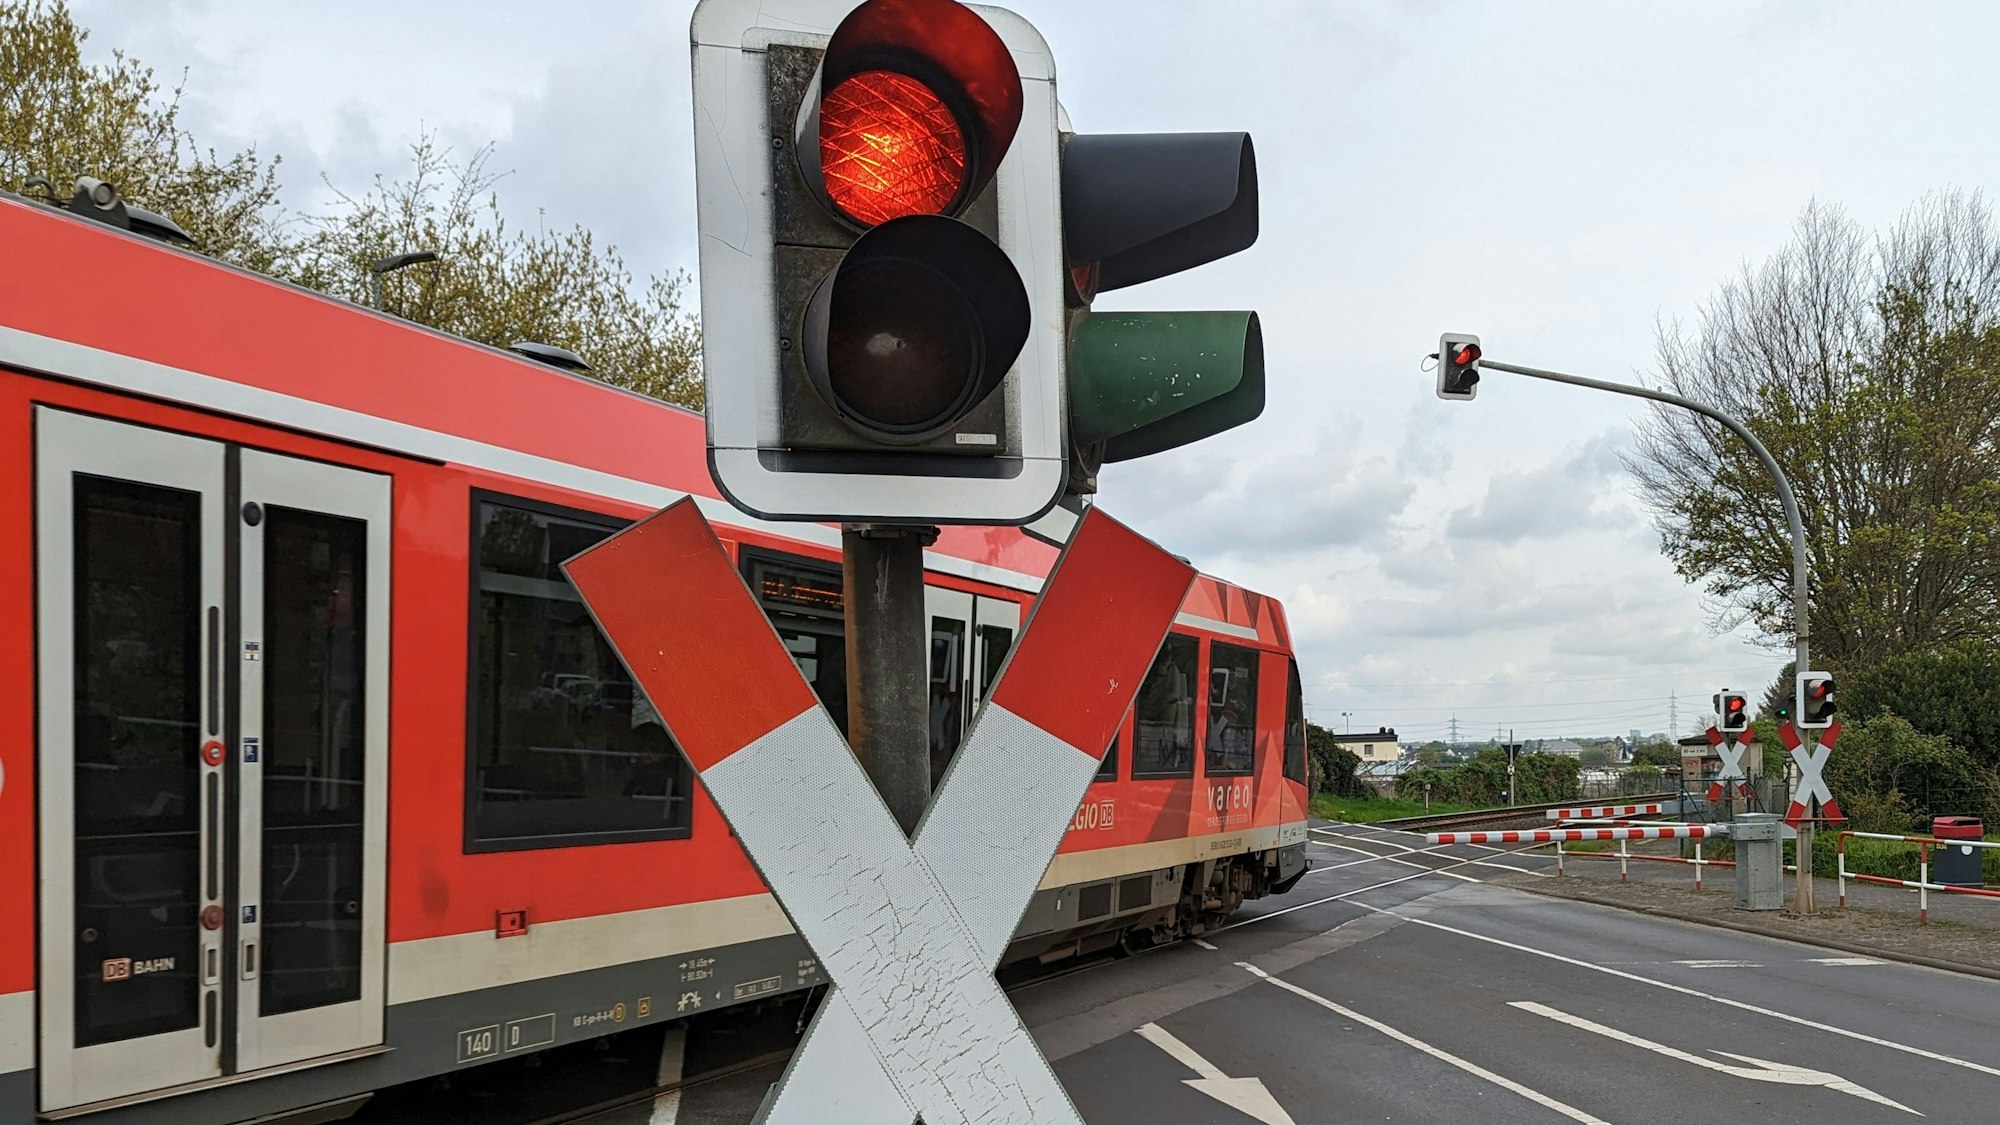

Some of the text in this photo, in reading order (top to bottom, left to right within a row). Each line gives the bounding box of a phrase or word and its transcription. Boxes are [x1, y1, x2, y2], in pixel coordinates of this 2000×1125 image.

[1208, 785, 1249, 811] vareo
[105, 957, 175, 980] DB BAHN
[466, 1032, 491, 1055] 140
[511, 1026, 520, 1045] D
